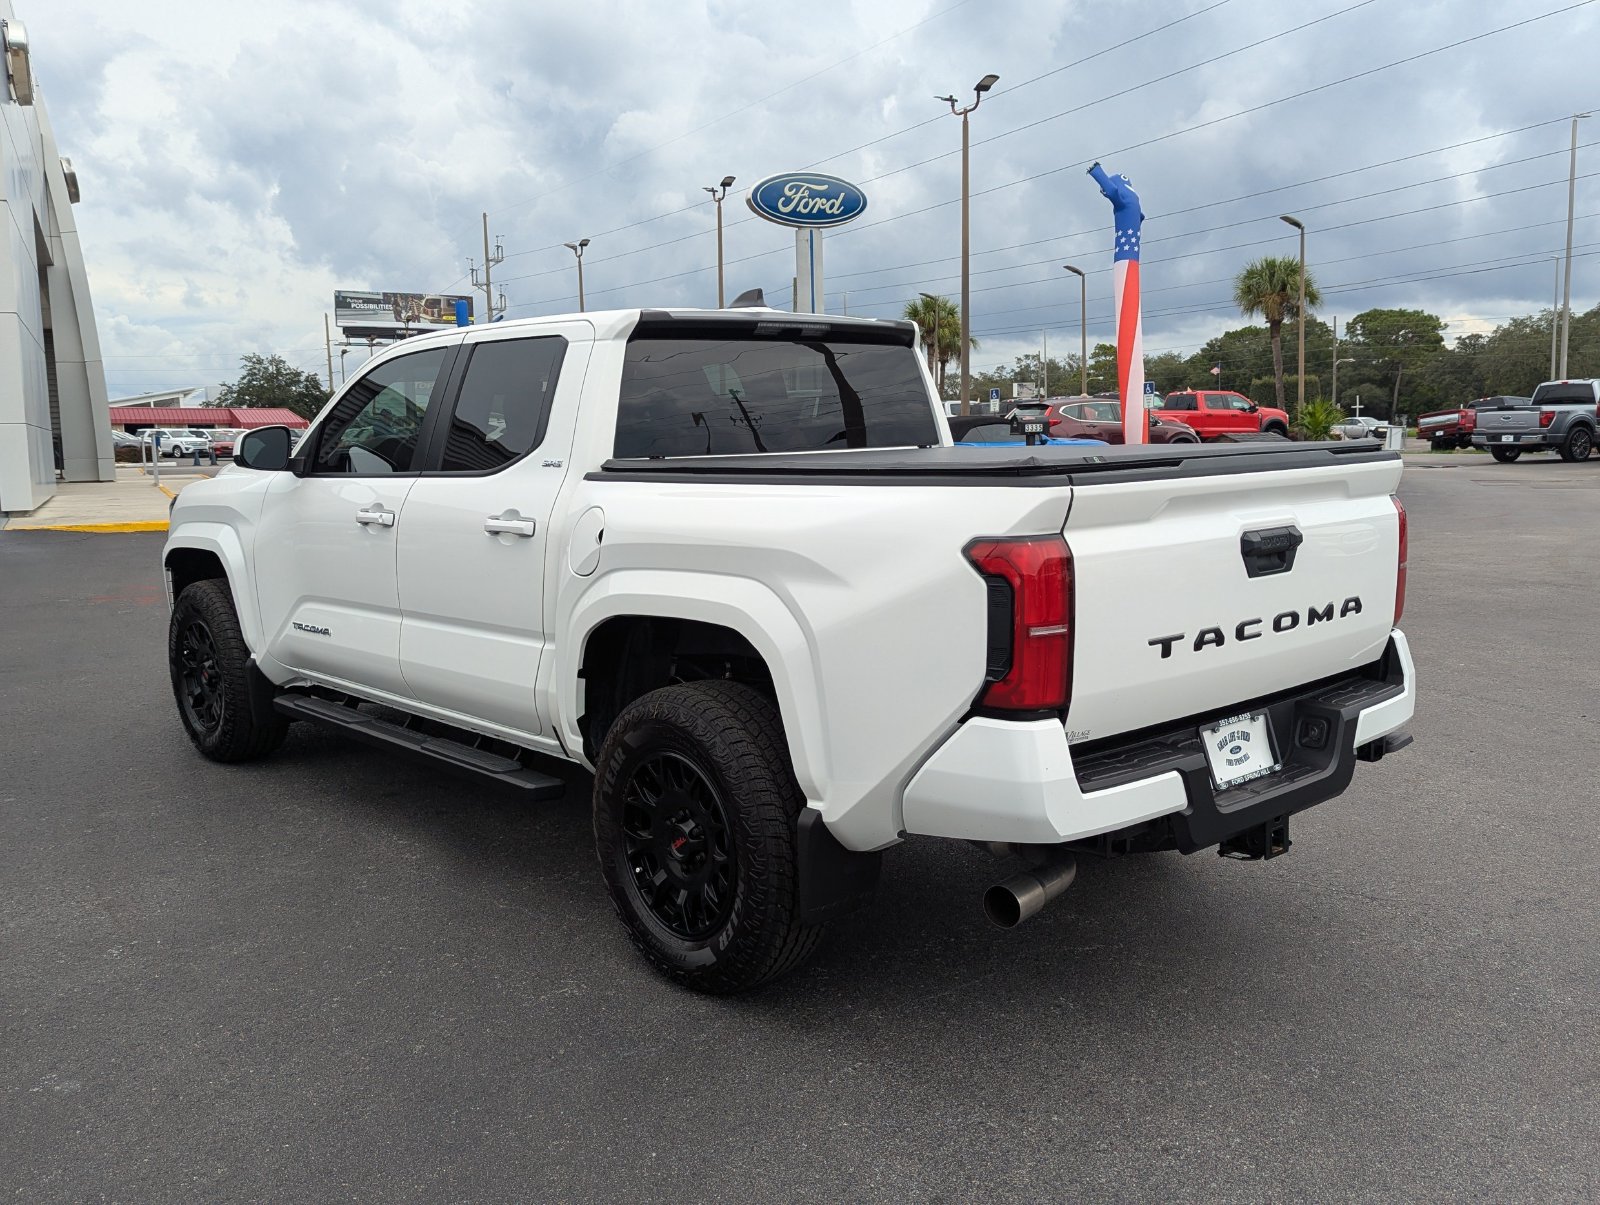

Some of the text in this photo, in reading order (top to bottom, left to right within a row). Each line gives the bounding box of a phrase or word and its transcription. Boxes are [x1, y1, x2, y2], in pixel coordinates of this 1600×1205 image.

[777, 182, 845, 214] Ford
[351, 303, 394, 311] POSSIBILITIES
[292, 621, 332, 637] TACOMA
[1148, 596, 1363, 659] TACOMA
